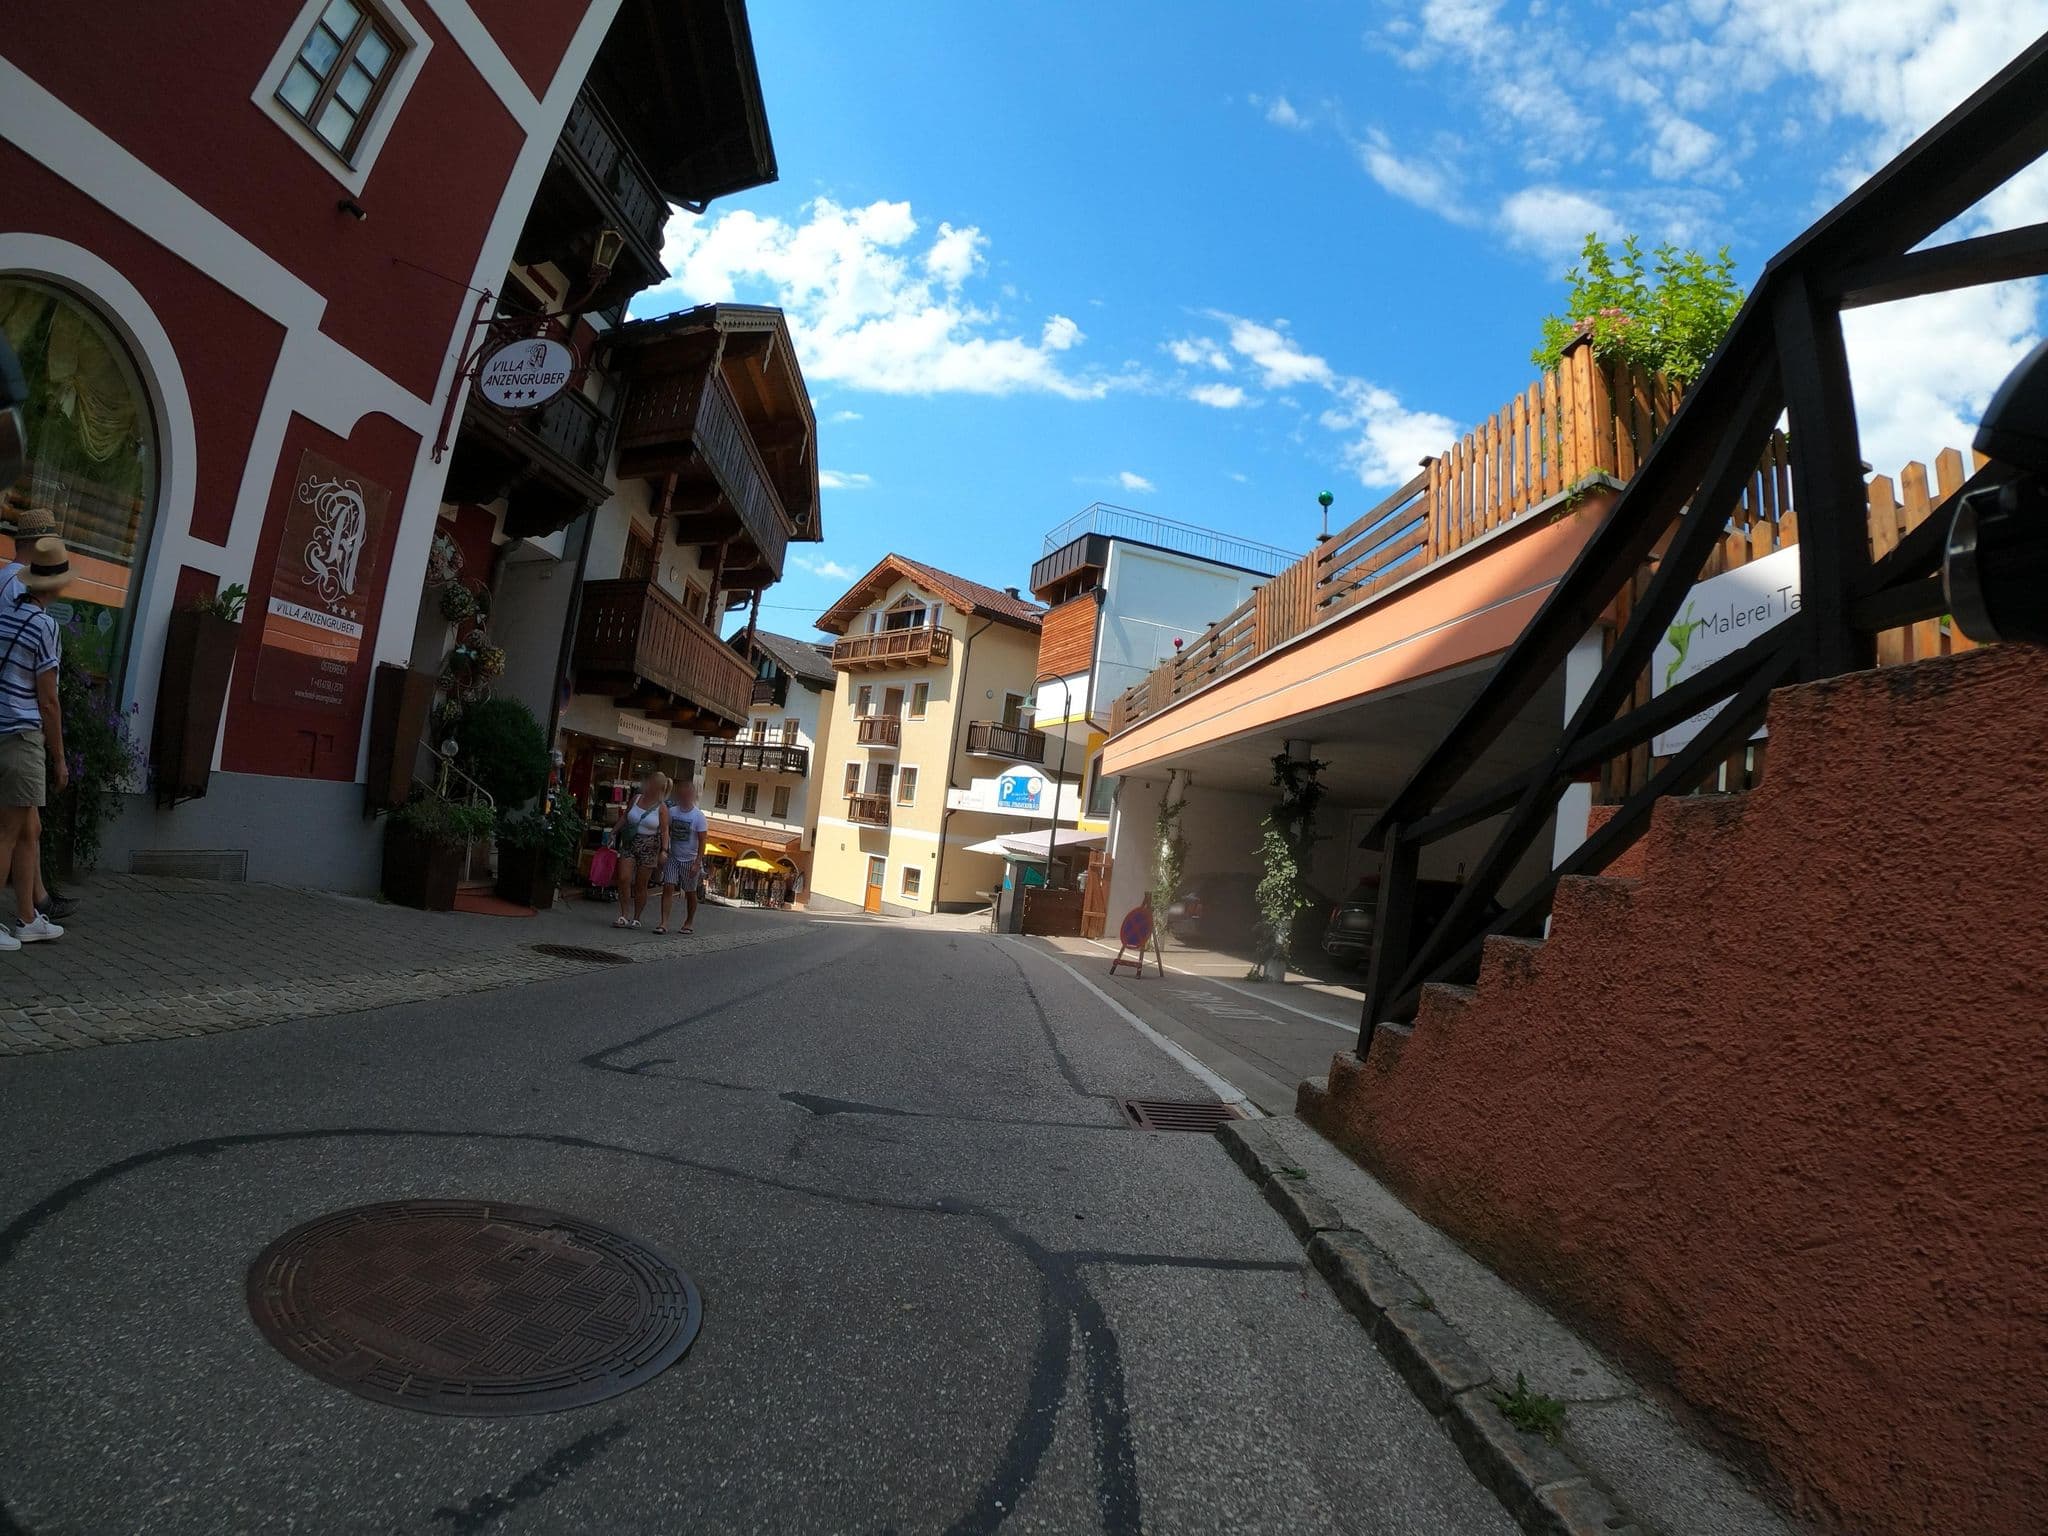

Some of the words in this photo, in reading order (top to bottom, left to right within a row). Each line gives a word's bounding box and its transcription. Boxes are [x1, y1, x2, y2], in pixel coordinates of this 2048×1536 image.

[492, 359, 524, 372] VILLA
[483, 372, 565, 387] ANZENGRUBER
[276, 603, 300, 618] VILLA
[301, 611, 355, 635] ANZENGRUBER
[1701, 594, 1771, 639] Malerei
